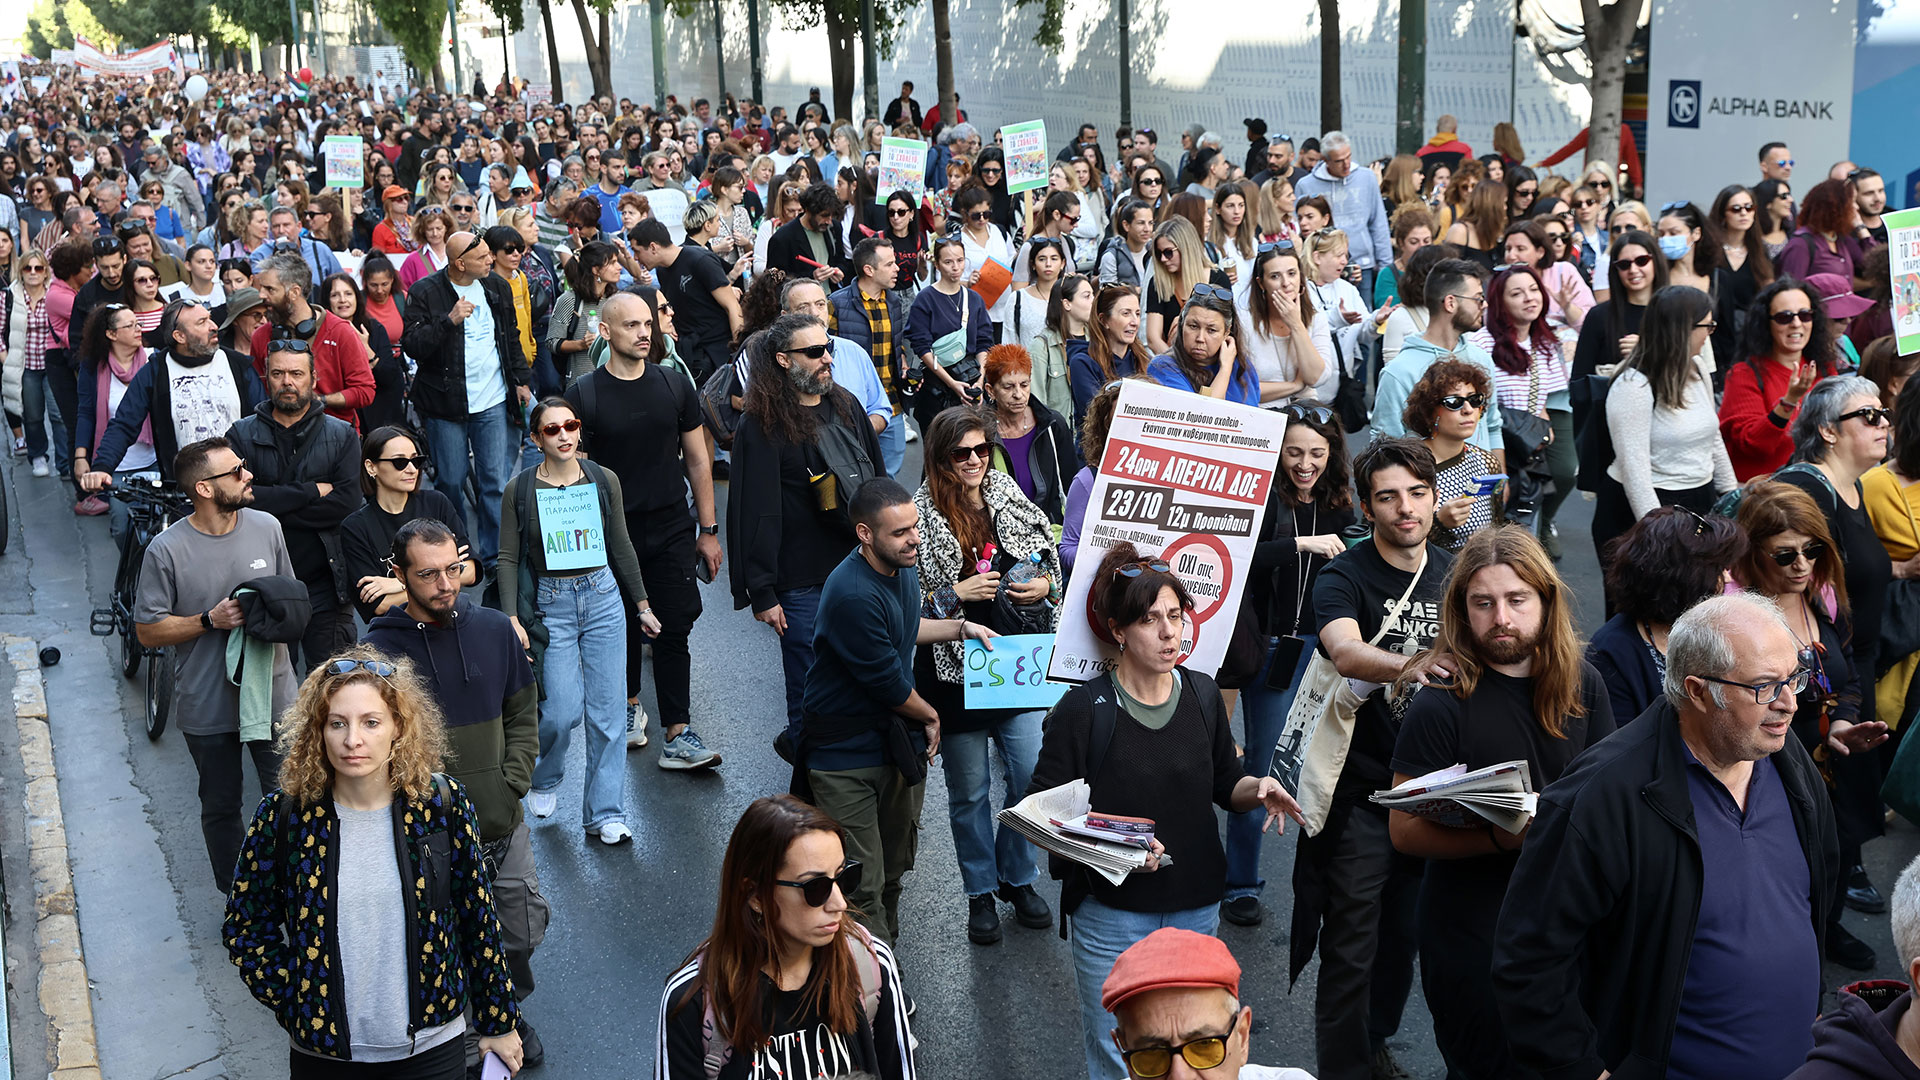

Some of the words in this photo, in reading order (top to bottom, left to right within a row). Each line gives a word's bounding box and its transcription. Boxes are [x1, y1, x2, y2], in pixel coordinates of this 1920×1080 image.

[1708, 97, 1770, 117] ALPHA
[1774, 99, 1833, 121] BANK
[1178, 412, 1185, 421] το
[1186, 411, 1213, 425] δημόσιο
[1214, 416, 1239, 428] σχολείο
[1142, 422, 1166, 435] Ενάντια
[1166, 427, 1183, 437] στην
[1183, 428, 1219, 443] κυβέρνηση
[1219, 433, 1230, 444] της
[1230, 435, 1270, 449] καταστροφής
[1113, 446, 1160, 479] 24ΩΡΗ
[1160, 455, 1228, 493] ΑΠΕΡΓΙΑ
[1227, 469, 1262, 499] ΔΟΕ
[1106, 488, 1165, 520] 23/10
[1166, 505, 1191, 530] 12μ
[1192, 512, 1250, 532] Προπύλαια
[1094, 524, 1117, 538] ΟΛΟΙ/ΕΣ
[1117, 529, 1128, 539] ΣΤΙΣ
[1128, 530, 1165, 546] ΑΠΕΡΓΙΑΚΕΣ
[1178, 553, 1198, 575] ΟΧΙ
[1197, 563, 1214, 580] στις
[1078, 658, 1088, 674] η
